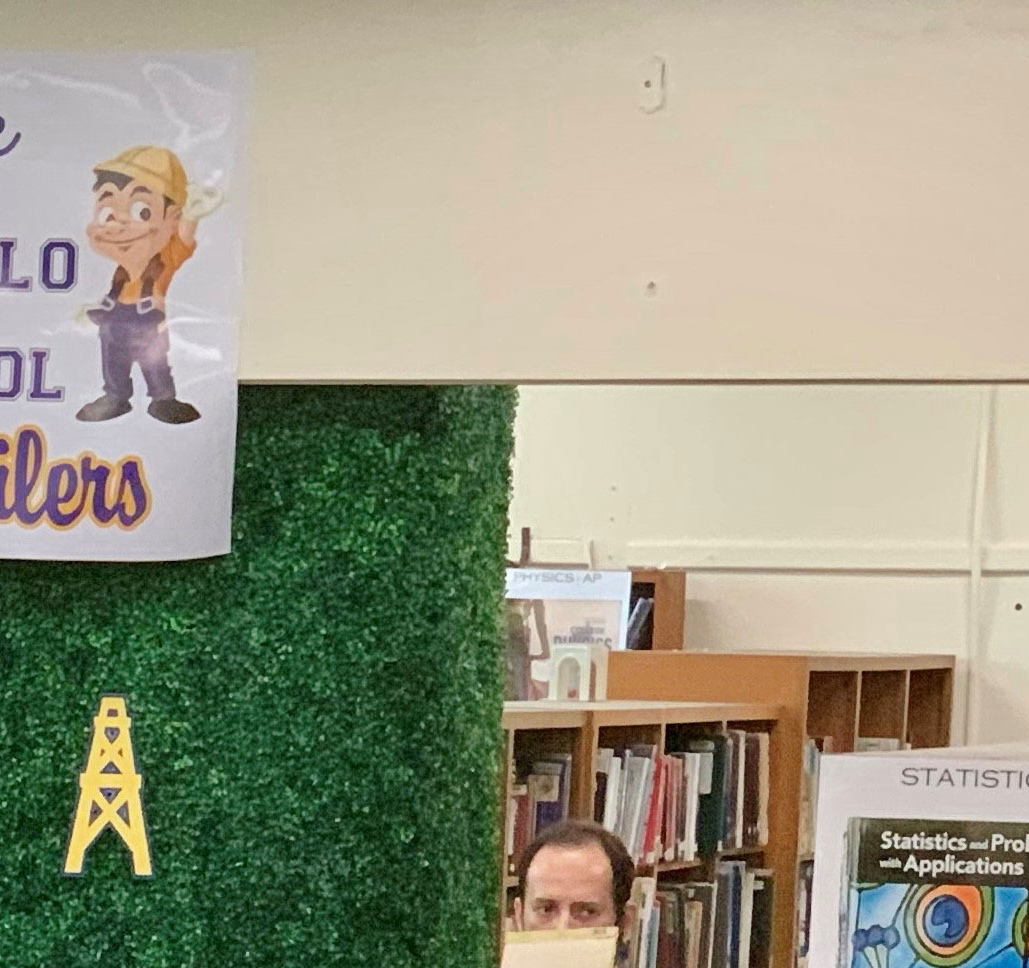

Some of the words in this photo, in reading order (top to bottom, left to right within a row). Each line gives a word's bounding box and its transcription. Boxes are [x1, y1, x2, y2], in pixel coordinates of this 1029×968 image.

[514, 571, 575, 583] PHYSICS
[582, 572, 602, 583] AP
[880, 831, 967, 851] Statistics
[969, 839, 988, 850] and
[879, 857, 902, 868] with
[903, 854, 1024, 878] Applications
